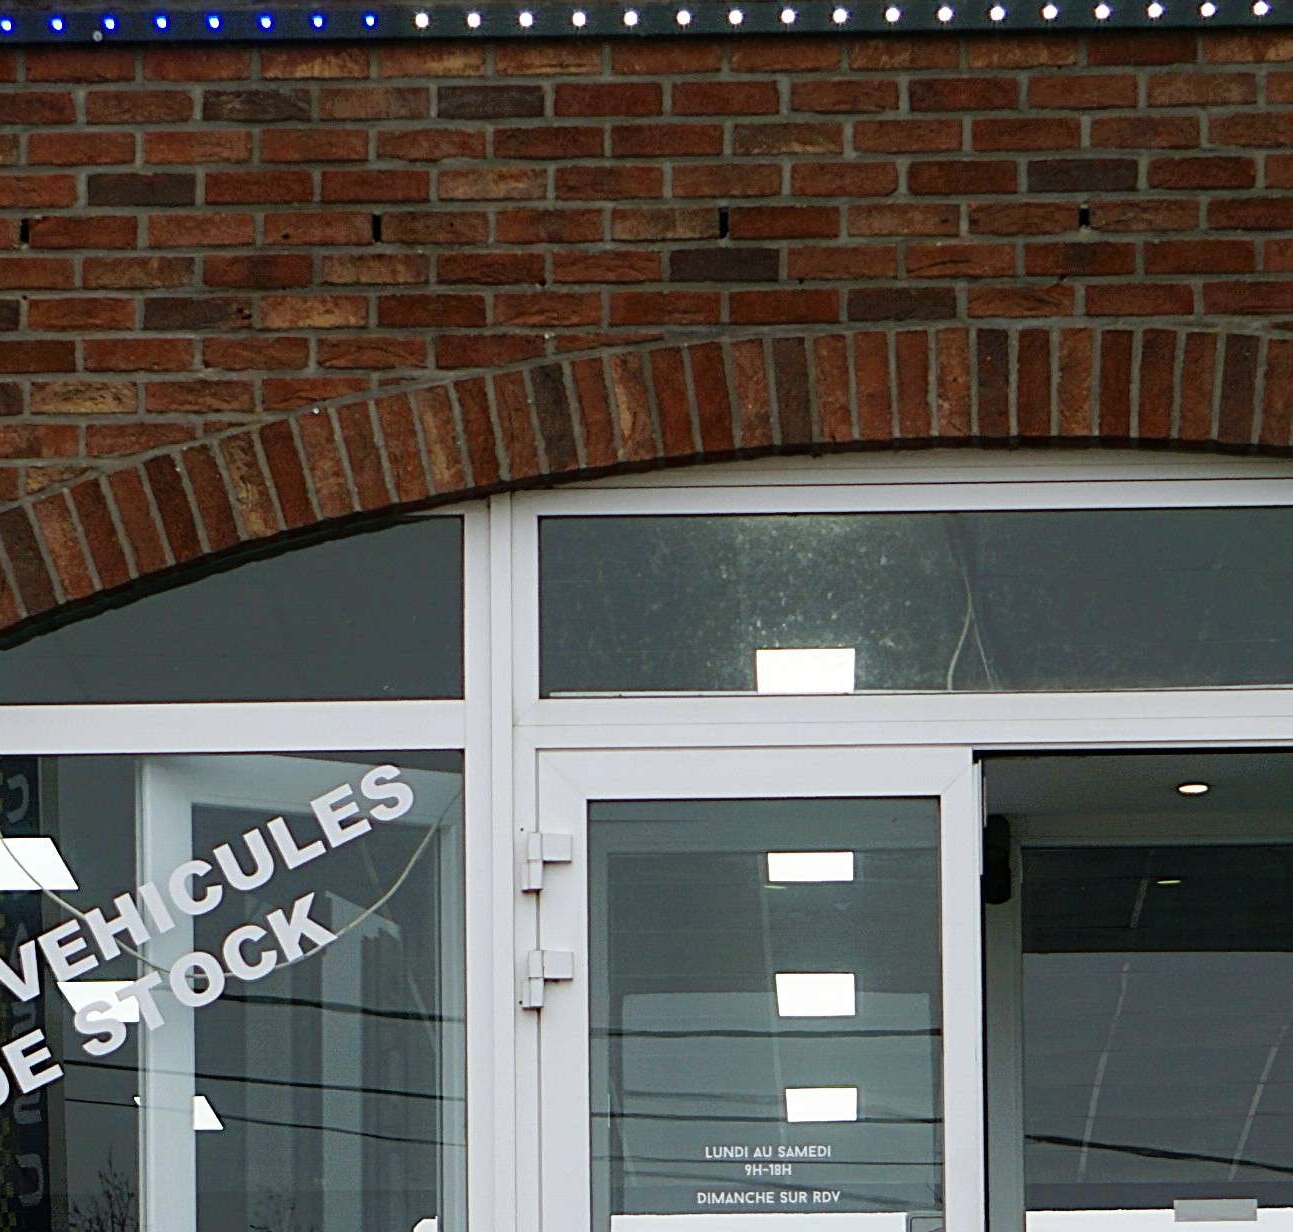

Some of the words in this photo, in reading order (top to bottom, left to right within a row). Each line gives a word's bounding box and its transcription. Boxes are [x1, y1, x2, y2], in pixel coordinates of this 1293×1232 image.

[73, 892, 338, 1057] STOCK
[705, 1146, 748, 1158] LUNDI
[753, 1146, 772, 1158] AU
[778, 1145, 831, 1158] SAMEDI
[744, 1164, 792, 1176] 9H-18H
[697, 1191, 775, 1204] DIMANCHE
[779, 1191, 808, 1204] SUR
[813, 1191, 841, 1203] RDV
